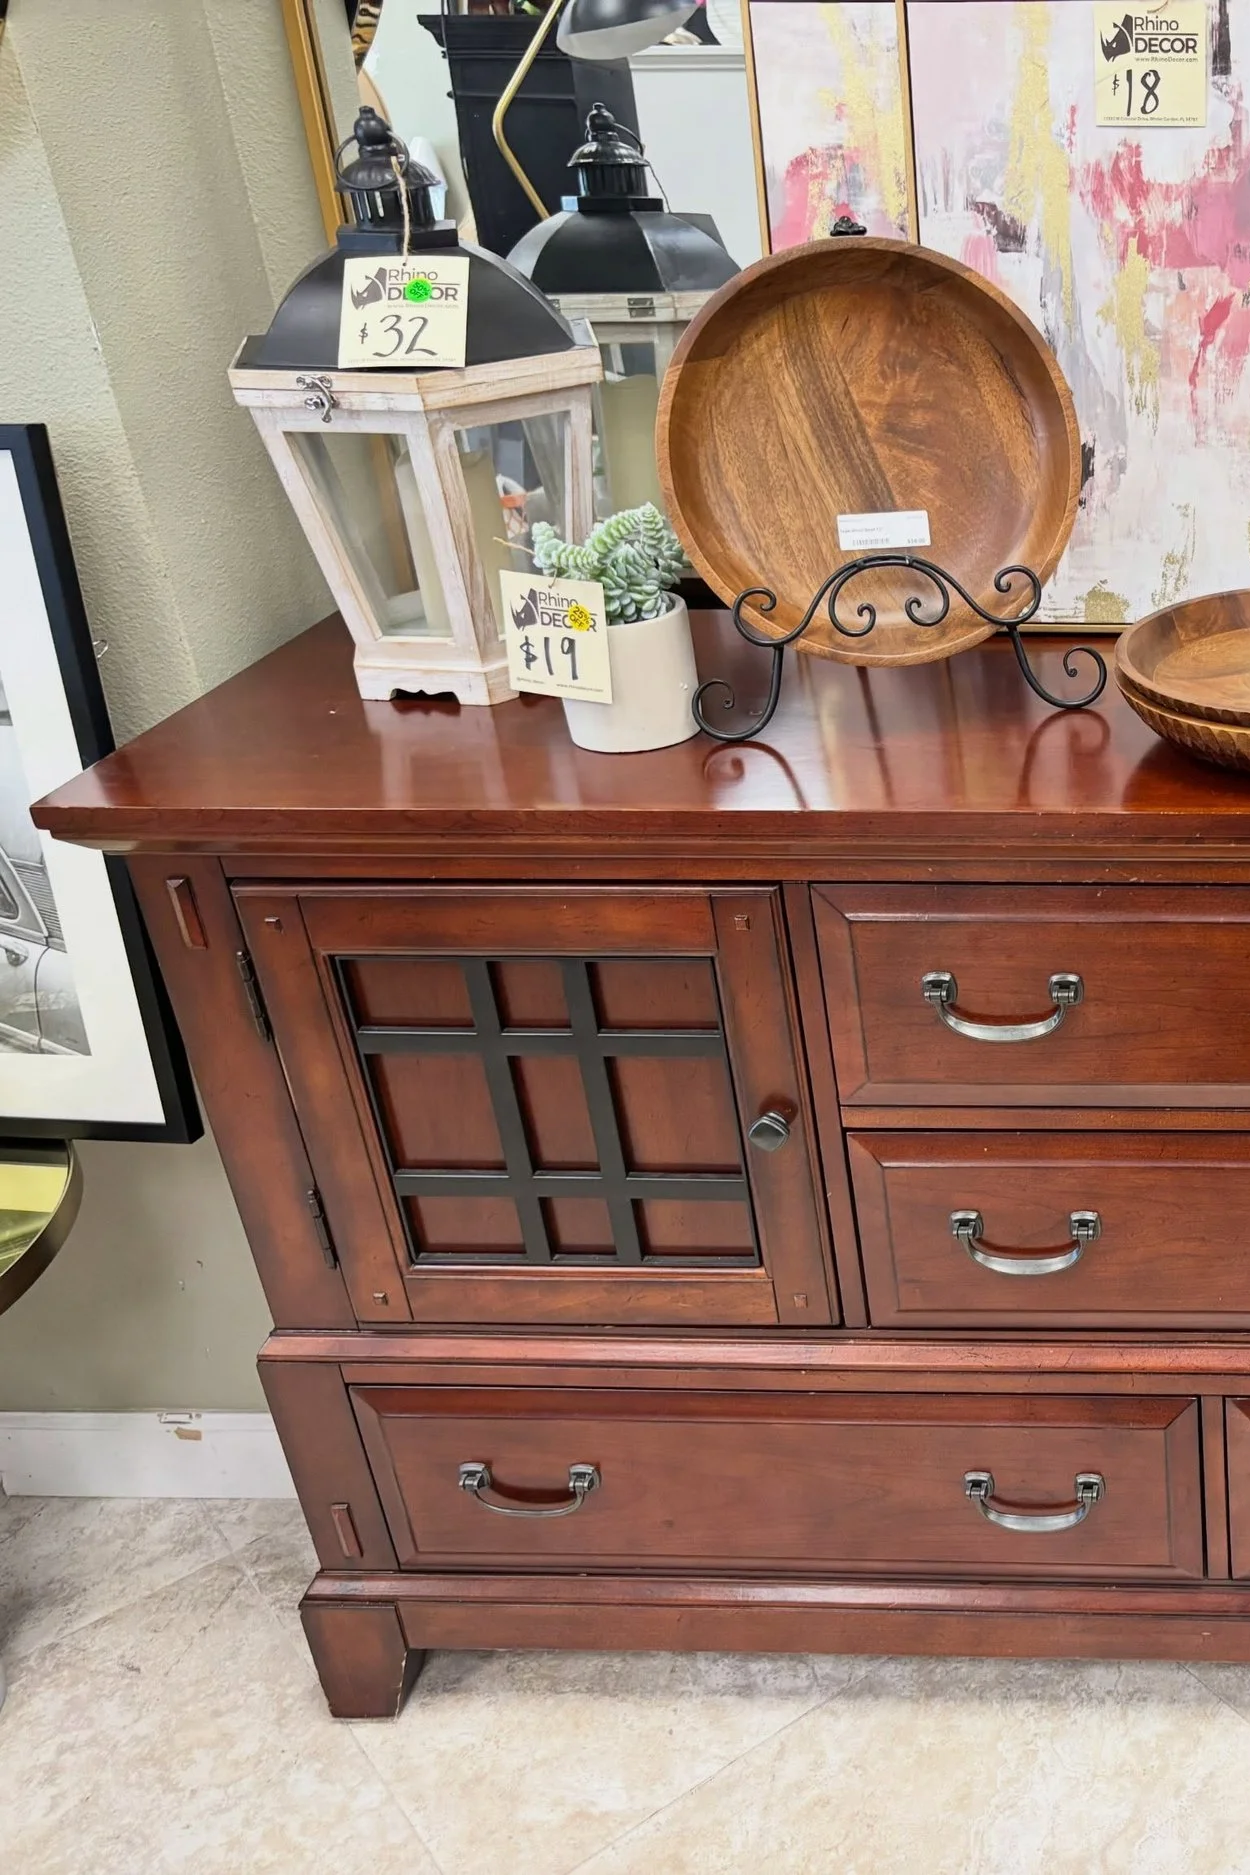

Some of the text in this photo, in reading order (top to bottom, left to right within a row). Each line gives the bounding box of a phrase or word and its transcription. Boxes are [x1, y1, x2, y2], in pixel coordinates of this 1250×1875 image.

[1134, 15, 1179, 31] Rhino
[1134, 37, 1198, 54] DECOR
[1112, 69, 1161, 117] $18
[388, 268, 439, 282] Rhino
[387, 287, 458, 301] DOR
[359, 314, 438, 357] $32
[540, 612, 597, 632] DECR
[573, 606, 589, 624] 25%
[520, 635, 578, 680] $19
